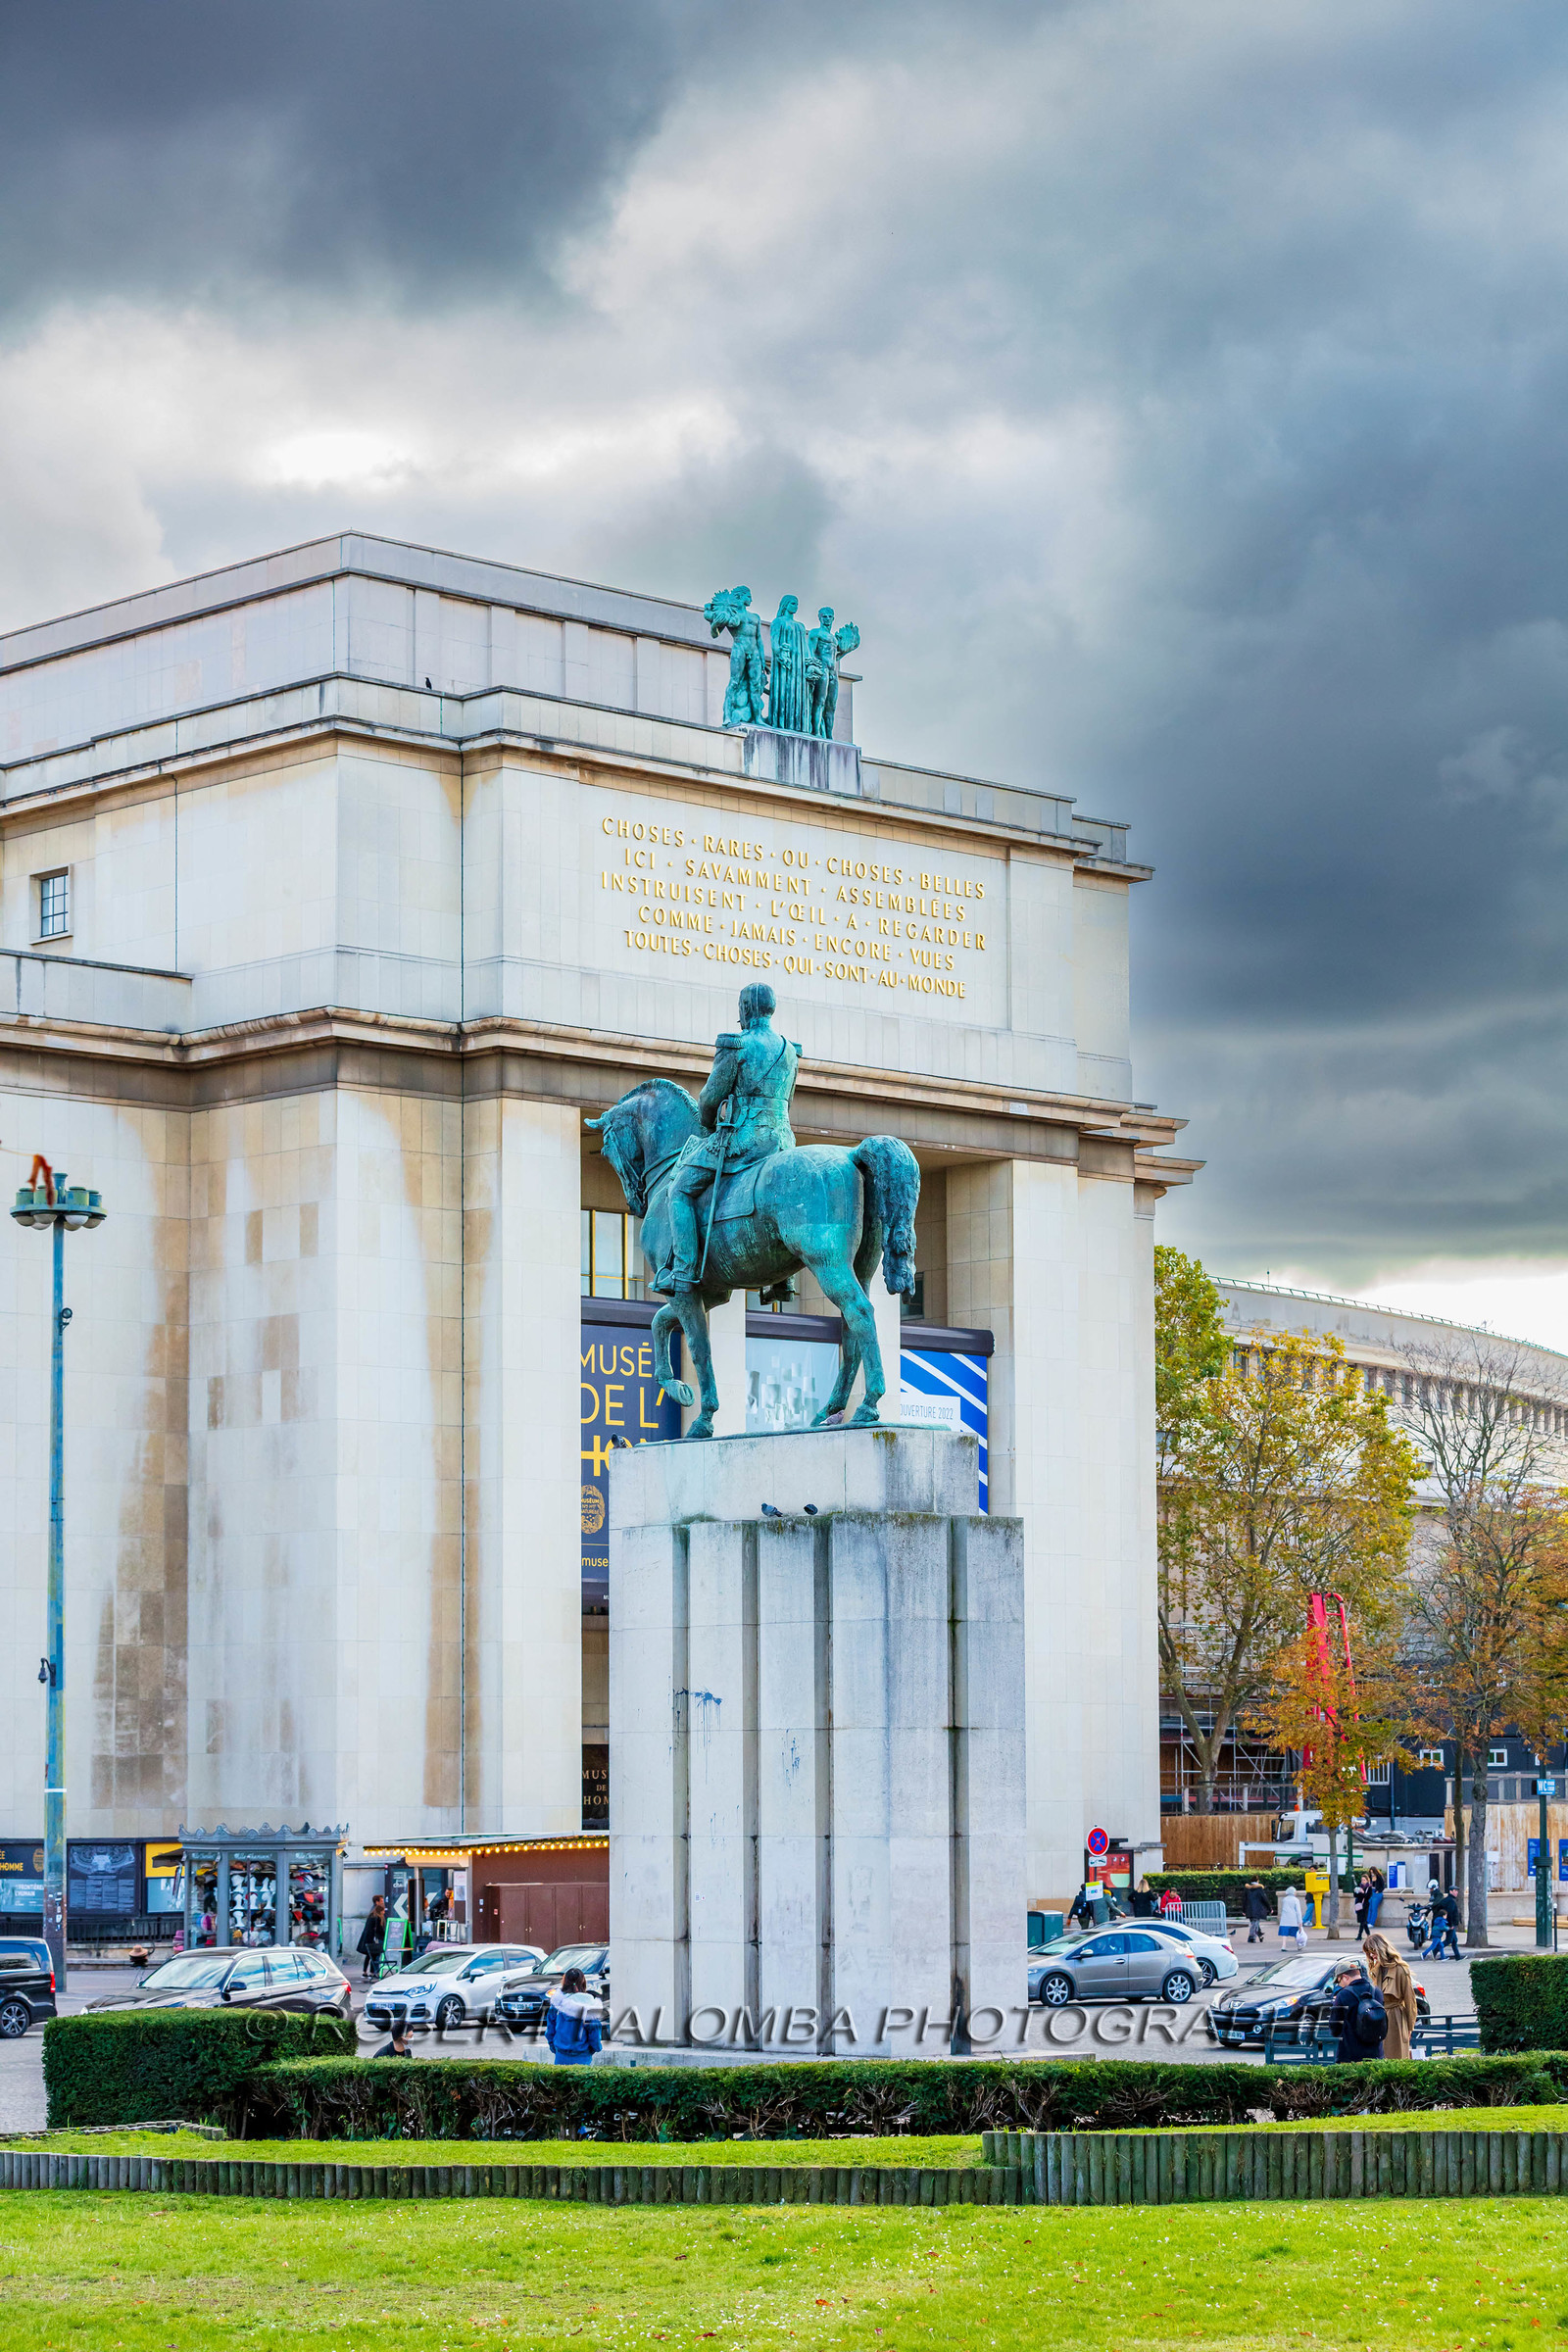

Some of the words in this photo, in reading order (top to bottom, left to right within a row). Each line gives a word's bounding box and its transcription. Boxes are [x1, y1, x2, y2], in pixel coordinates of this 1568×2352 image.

[603, 817, 685, 847] CHOSES
[704, 835, 763, 860] RARES
[782, 850, 809, 869] OU
[827, 858, 903, 885] CHOSES
[920, 873, 985, 900] BELLES
[625, 849, 656, 870] ICI
[686, 859, 811, 896] SAVAMMENT
[837, 886, 965, 922] ASSEMBLÉES
[602, 871, 744, 911] INSTRUISENT
[847, 913, 858, 930] A
[879, 917, 986, 951] REGARDER
[639, 906, 713, 934] COMME
[731, 920, 796, 947] JAMAIS
[815, 933, 892, 961] ENCORE
[910, 949, 954, 970] VUES
[624, 931, 692, 956] TOUTES
[704, 943, 772, 968] CHOSES
[784, 956, 812, 975] QUI
[824, 961, 869, 983] SONT
[878, 970, 899, 988] AU
[907, 974, 965, 999] MONDE
[581, 1343, 653, 1378] MUSÉ
[938, 1406, 954, 1420] 2022
